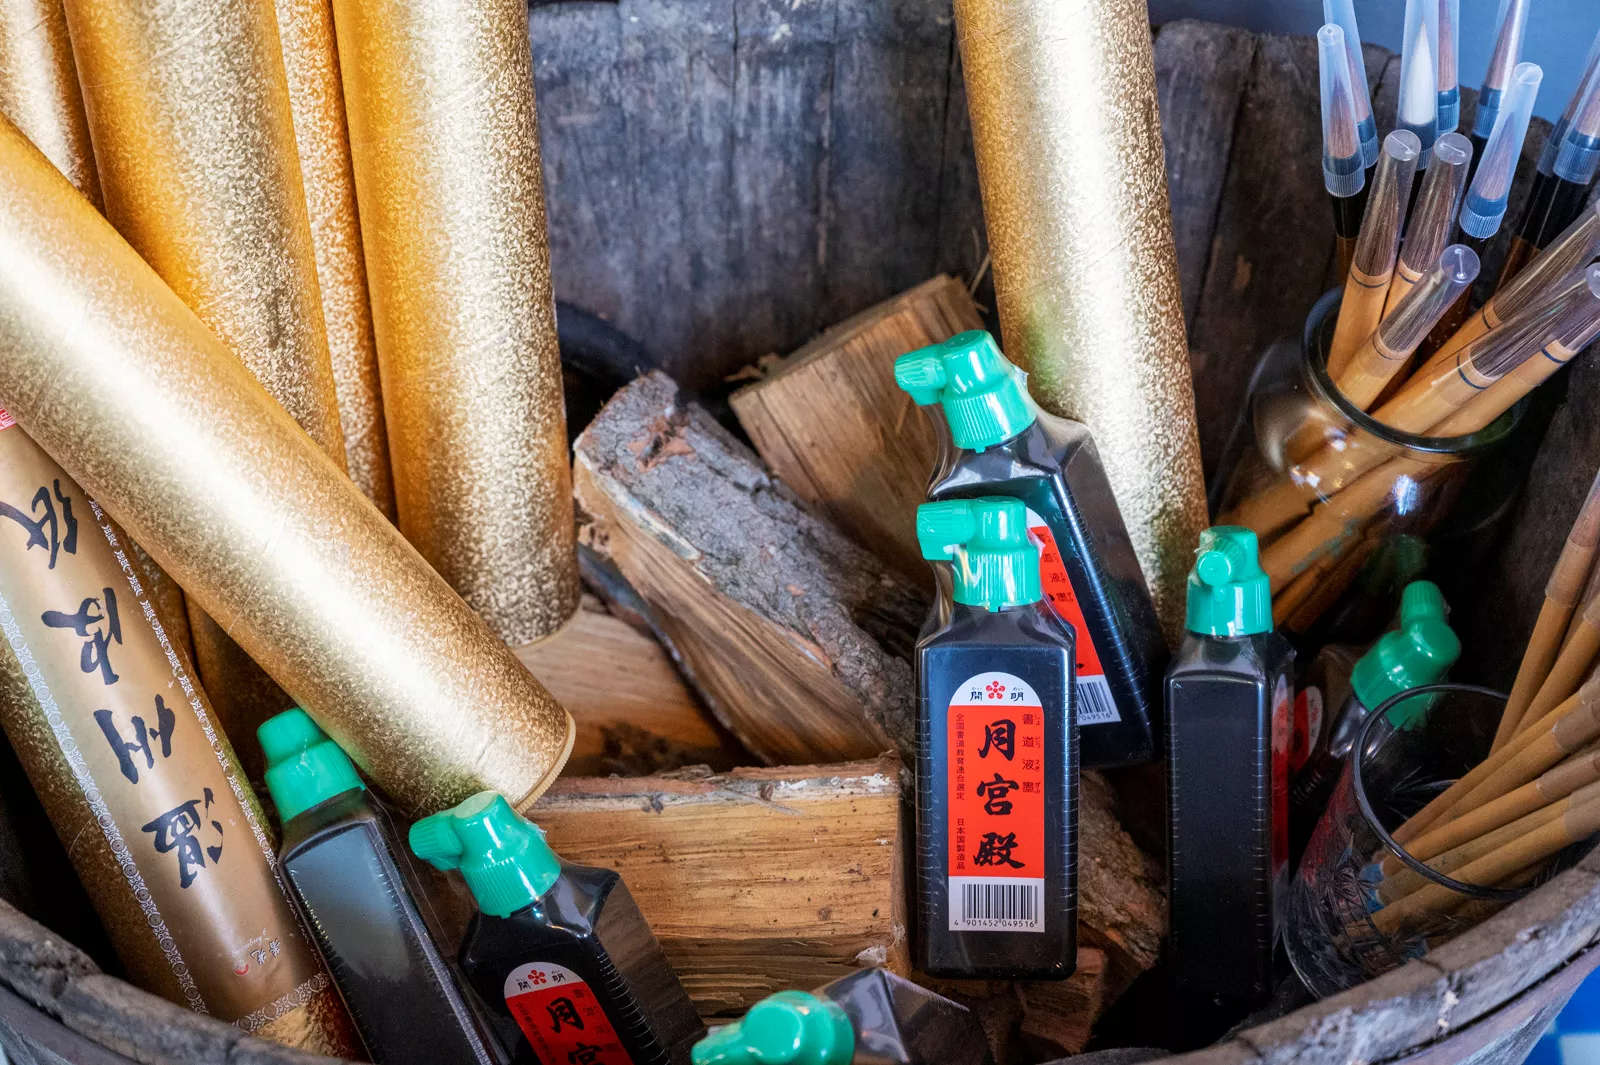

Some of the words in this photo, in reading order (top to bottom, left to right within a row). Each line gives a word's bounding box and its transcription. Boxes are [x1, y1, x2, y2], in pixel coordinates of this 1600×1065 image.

[955, 713, 966, 801] 全国書道教育連合選定
[1022, 713, 1035, 793] 書道液墨
[973, 719, 1026, 869] 月宮殿
[956, 818, 966, 870] 日本国製造品
[966, 919, 999, 927] 901452
[1001, 919, 1035, 928] 049516
